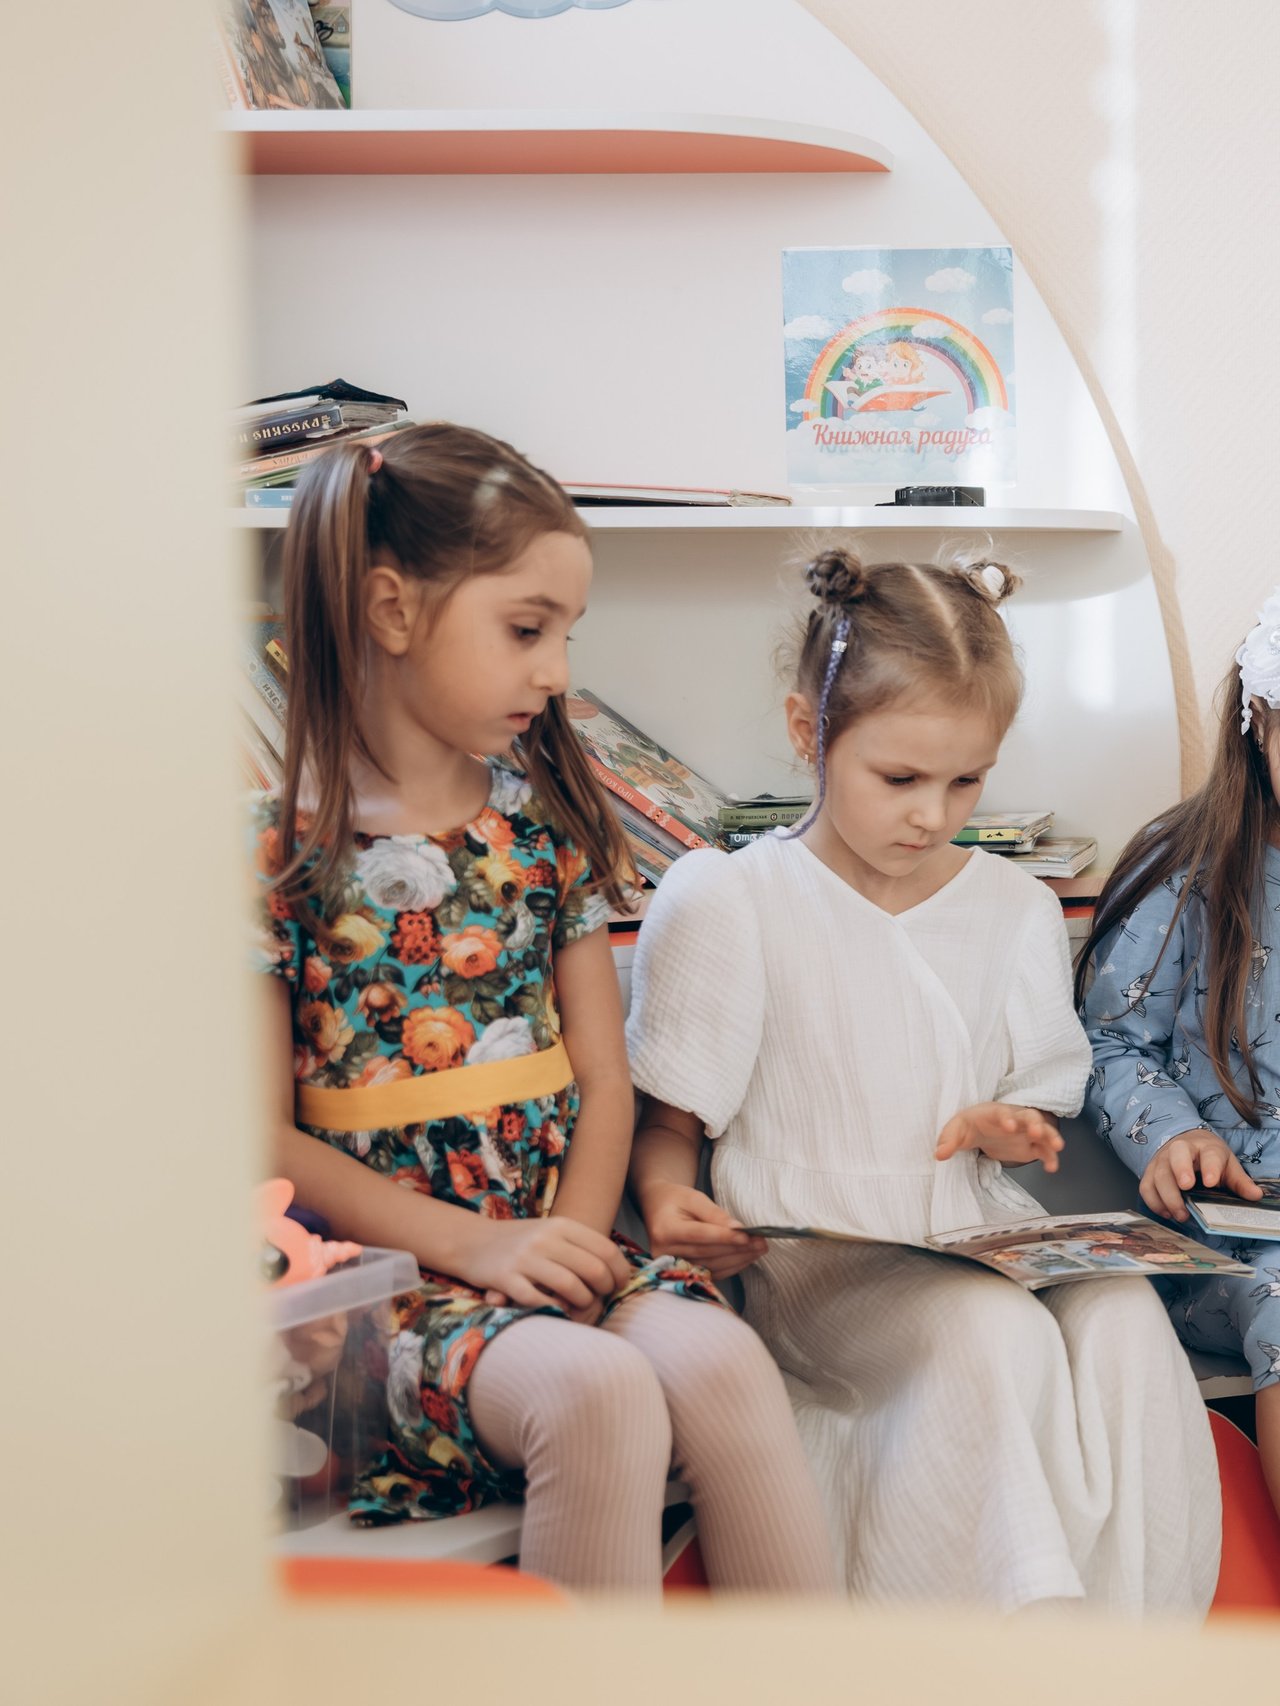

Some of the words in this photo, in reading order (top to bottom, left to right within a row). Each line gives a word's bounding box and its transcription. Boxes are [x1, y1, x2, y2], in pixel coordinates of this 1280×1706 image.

[812, 423, 913, 446] Книжная
[917, 427, 993, 455] радуга
[617, 786, 635, 801] ПРО
